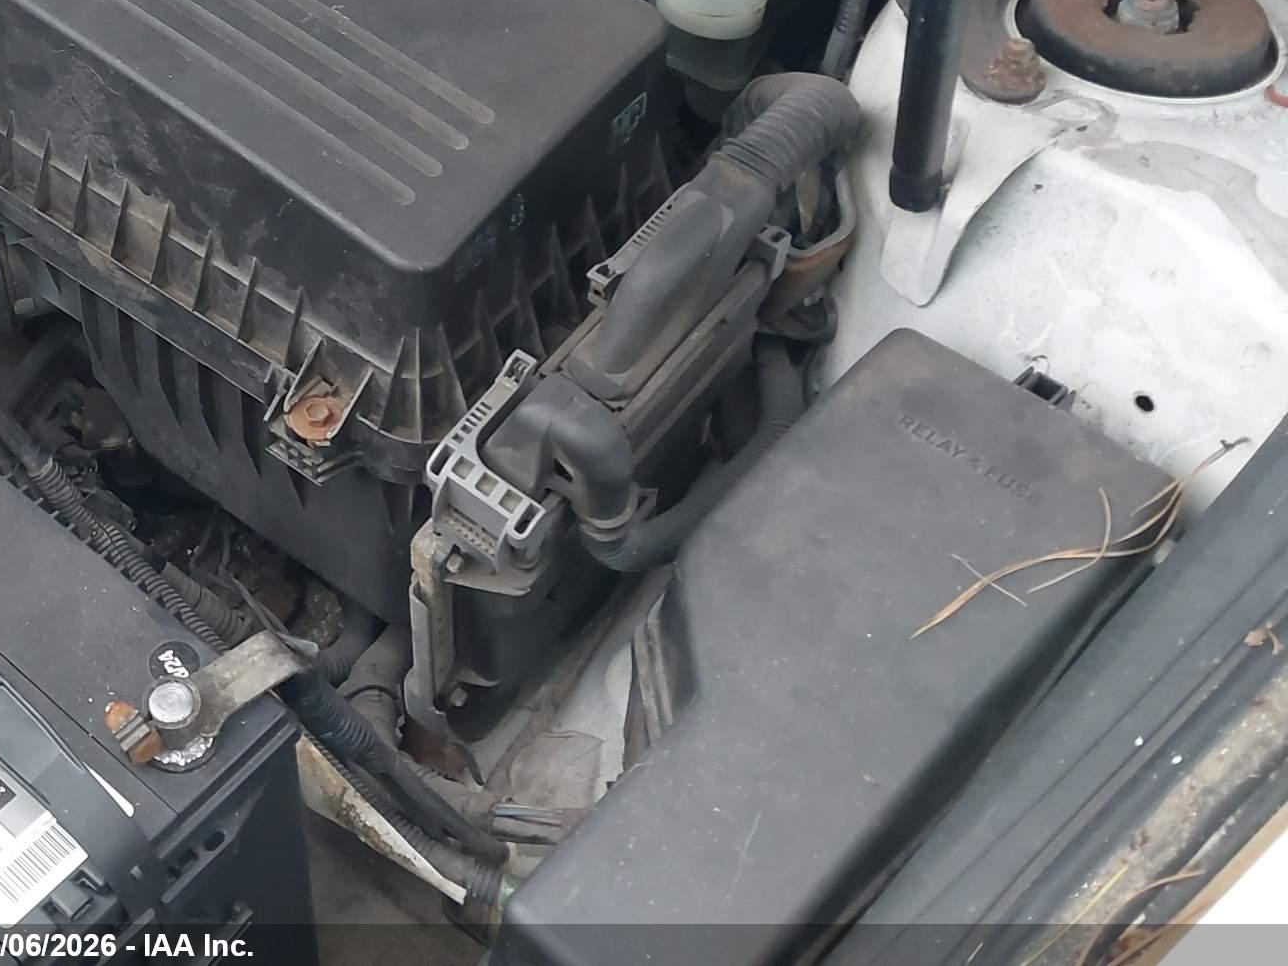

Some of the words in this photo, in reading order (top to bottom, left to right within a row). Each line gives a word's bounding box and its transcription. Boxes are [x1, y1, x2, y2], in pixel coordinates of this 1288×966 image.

[897, 414, 968, 460] RELAY
[967, 455, 986, 473] &
[985, 465, 1046, 508] FUSE
